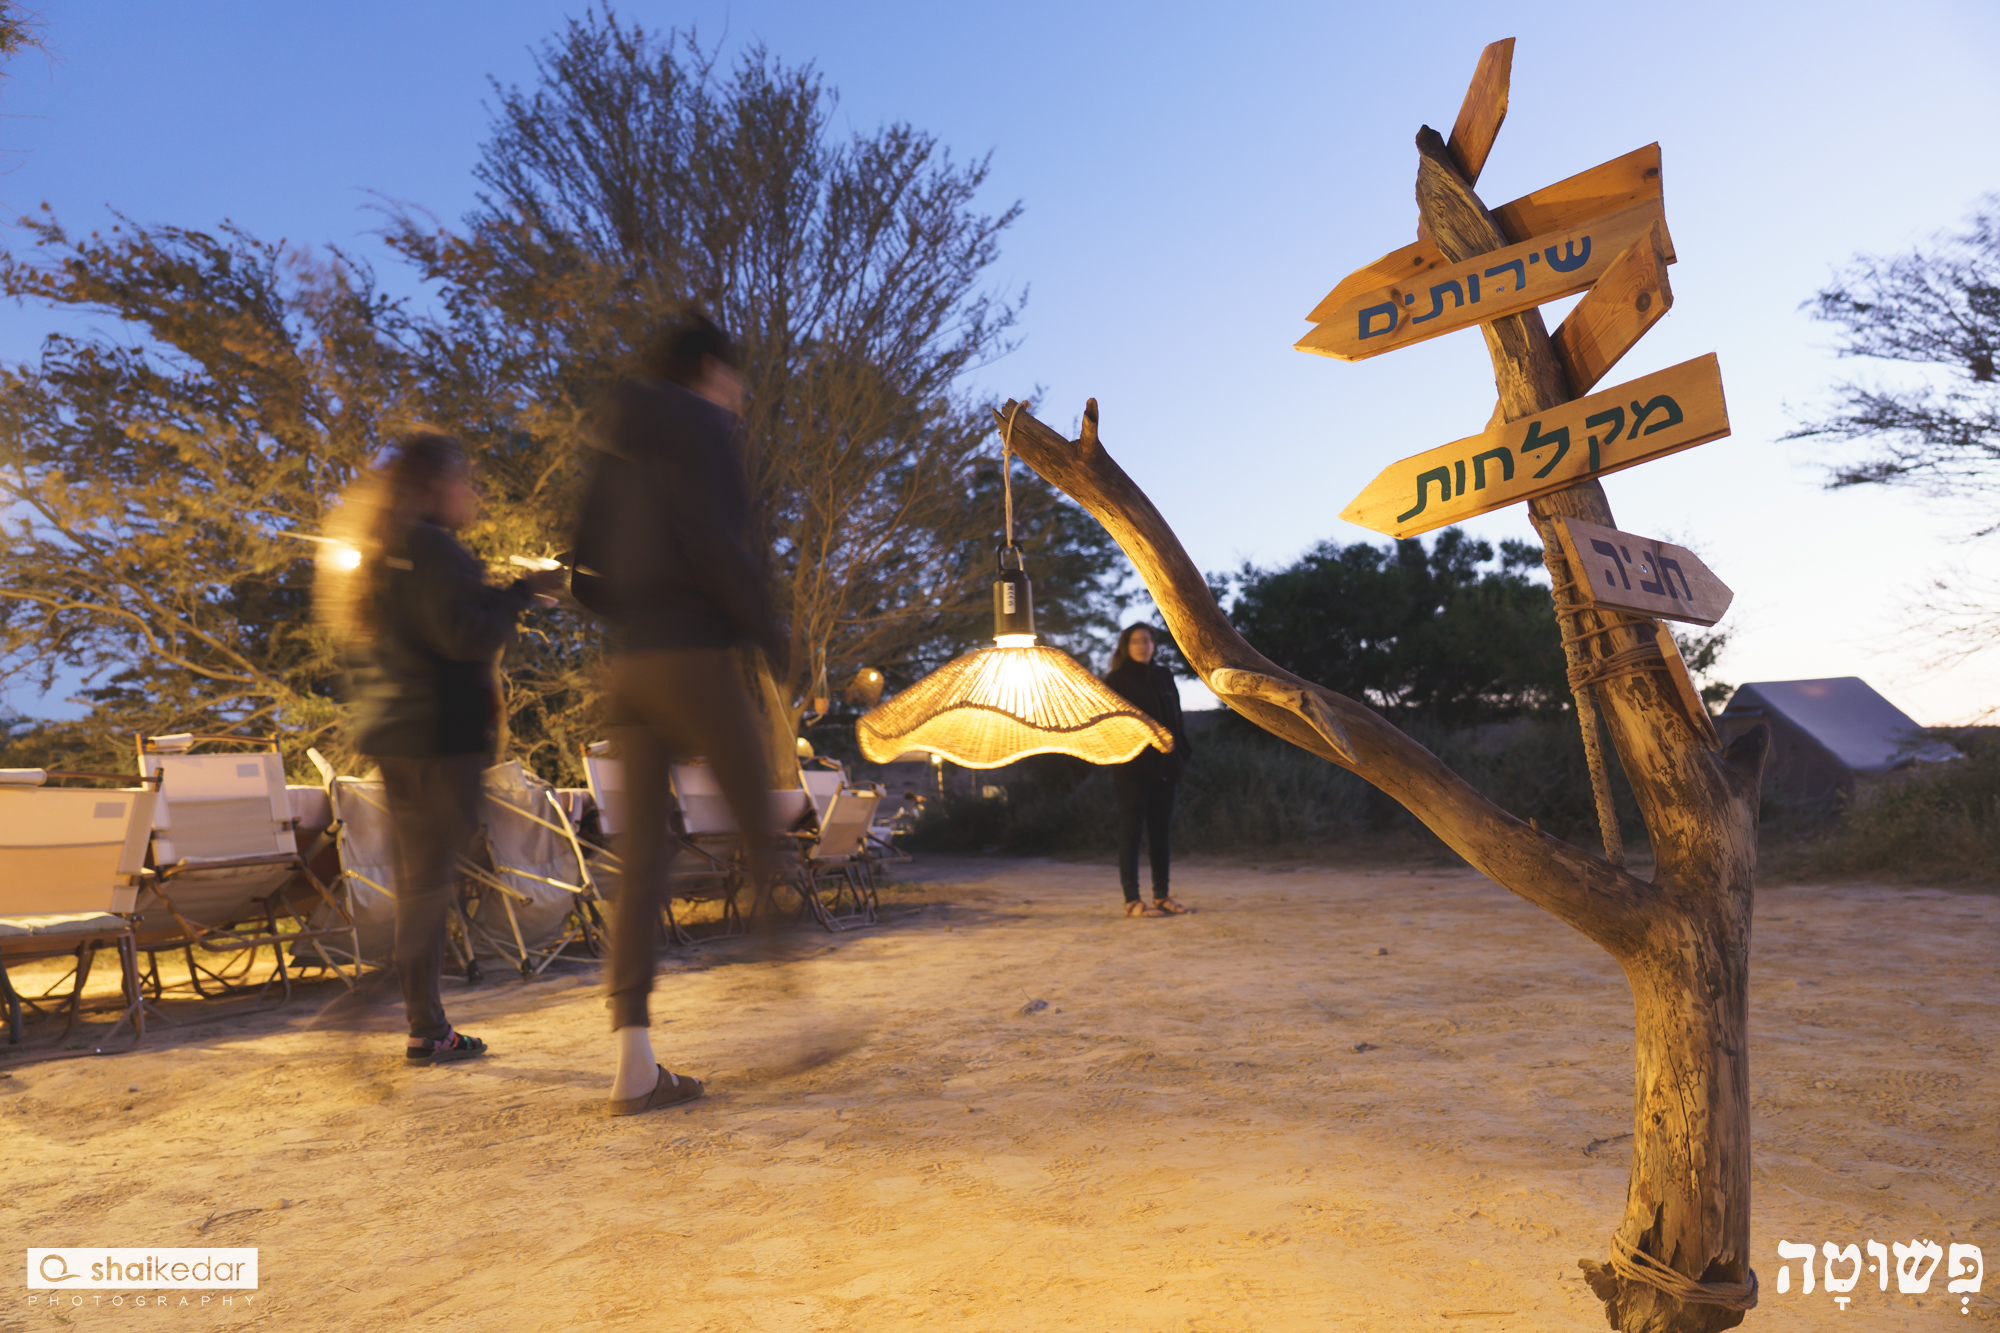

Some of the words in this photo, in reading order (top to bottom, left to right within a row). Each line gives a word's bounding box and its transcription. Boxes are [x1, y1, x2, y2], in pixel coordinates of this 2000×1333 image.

[1358, 235, 1592, 341] שירותים
[1396, 394, 1684, 524] מקלחות
[1589, 537, 1694, 602] חניה
